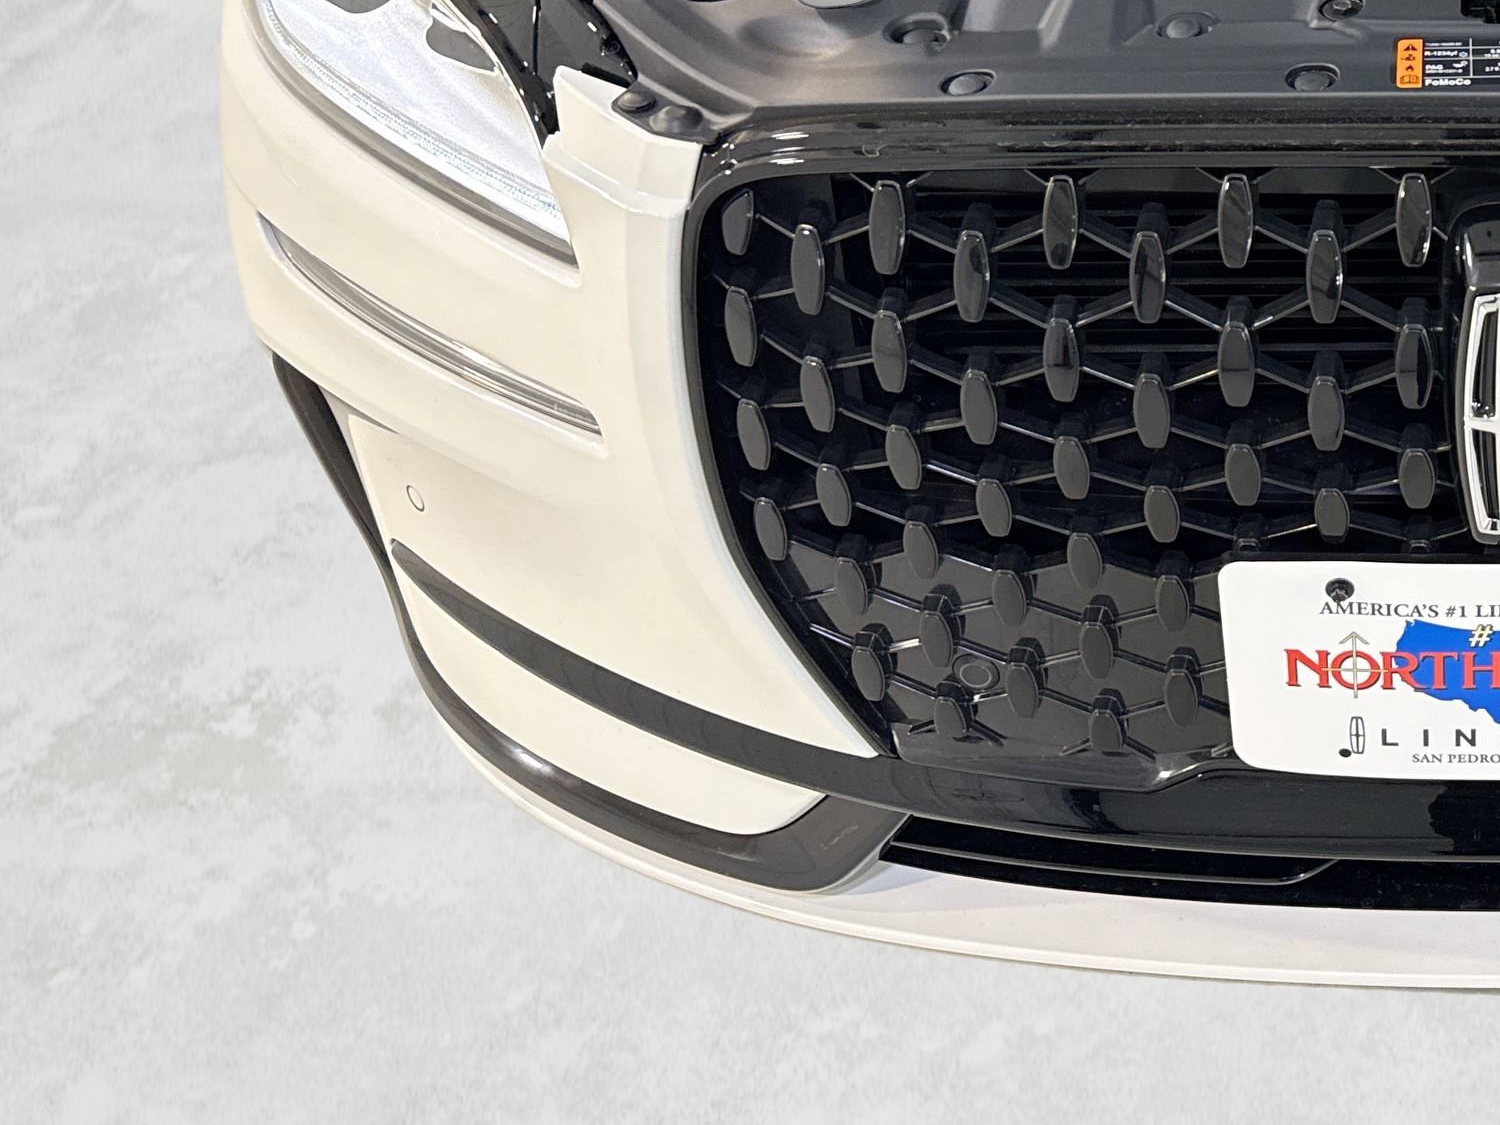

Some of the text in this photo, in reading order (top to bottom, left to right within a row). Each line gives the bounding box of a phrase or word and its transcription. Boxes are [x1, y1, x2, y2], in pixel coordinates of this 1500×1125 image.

[1424, 78, 1472, 86] FoMoCo
[1319, 601, 1439, 618] AMERICA'S
[1445, 605, 1468, 618] #1
[1411, 753, 1443, 764] SAN
